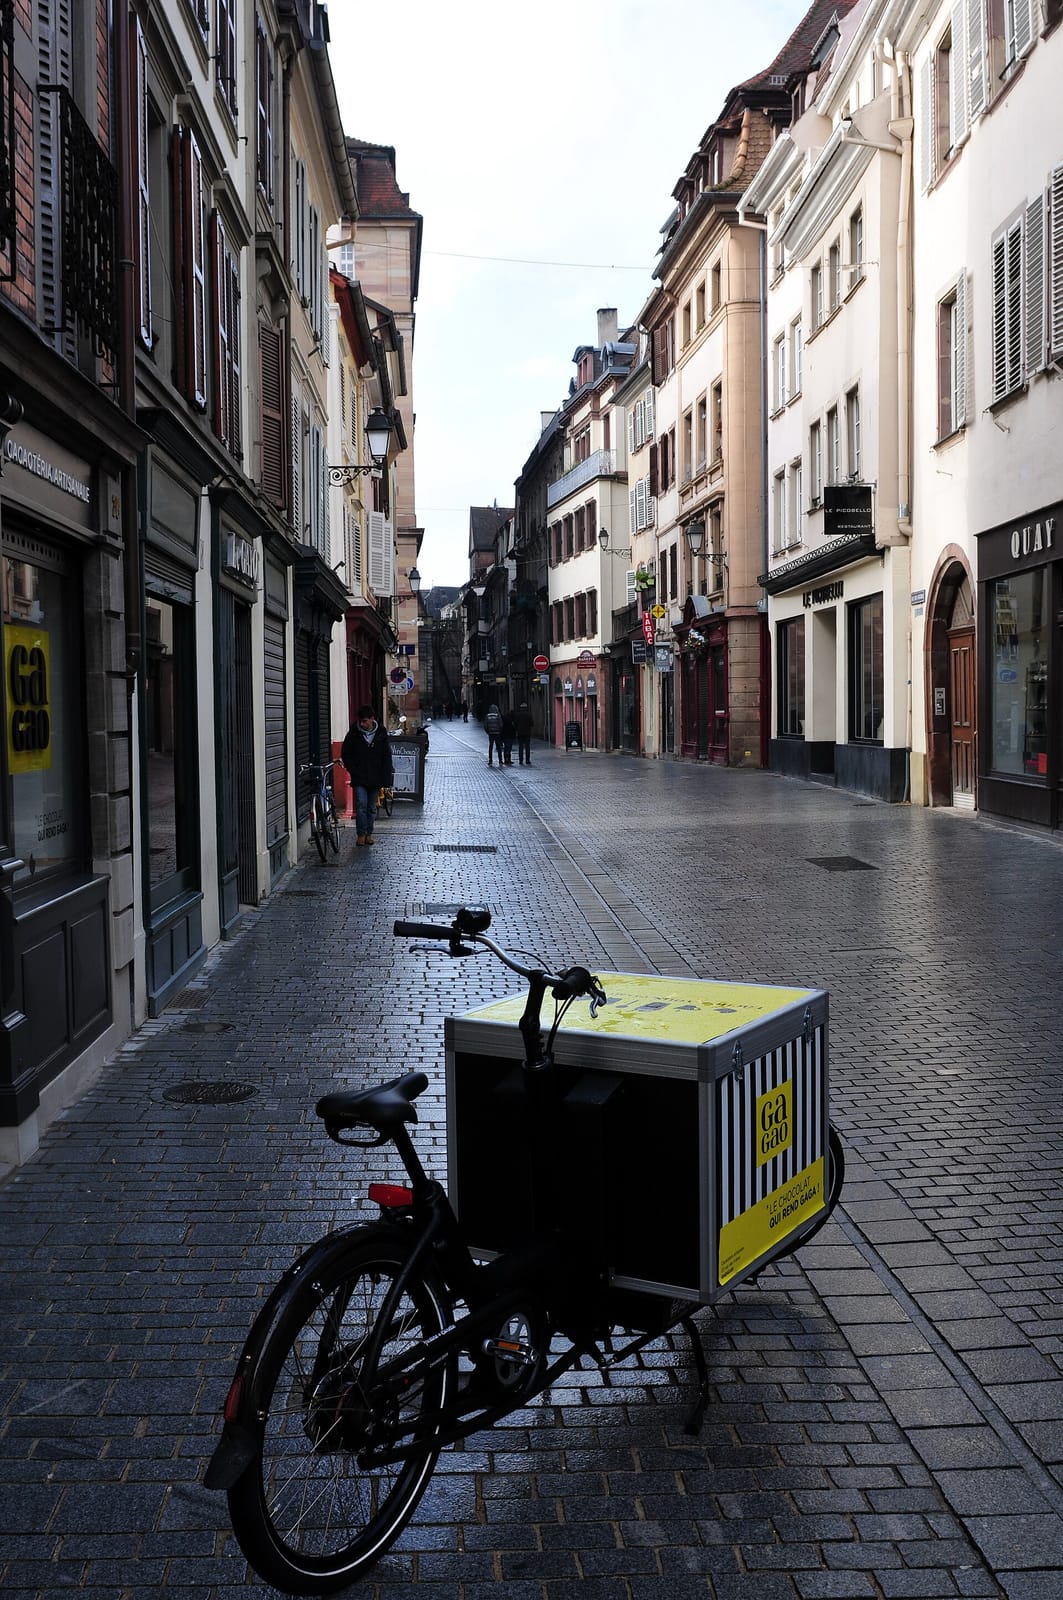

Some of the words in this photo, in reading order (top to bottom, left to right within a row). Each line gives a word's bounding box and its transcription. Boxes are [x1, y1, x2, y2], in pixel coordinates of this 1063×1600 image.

[7, 440, 53, 480] CACAOTÉRIA
[53, 467, 90, 503] ARTISANALE
[1011, 518, 1056, 559] QUAY
[802, 592, 812, 609] LE
[644, 612, 655, 645] TABAC
[761, 1093, 788, 1132] Ga
[769, 1212, 781, 1229] QUI
[782, 1200, 799, 1220] REND
[799, 1186, 817, 1206] GAGA
[778, 1175, 811, 1208] CHOCOLAT
